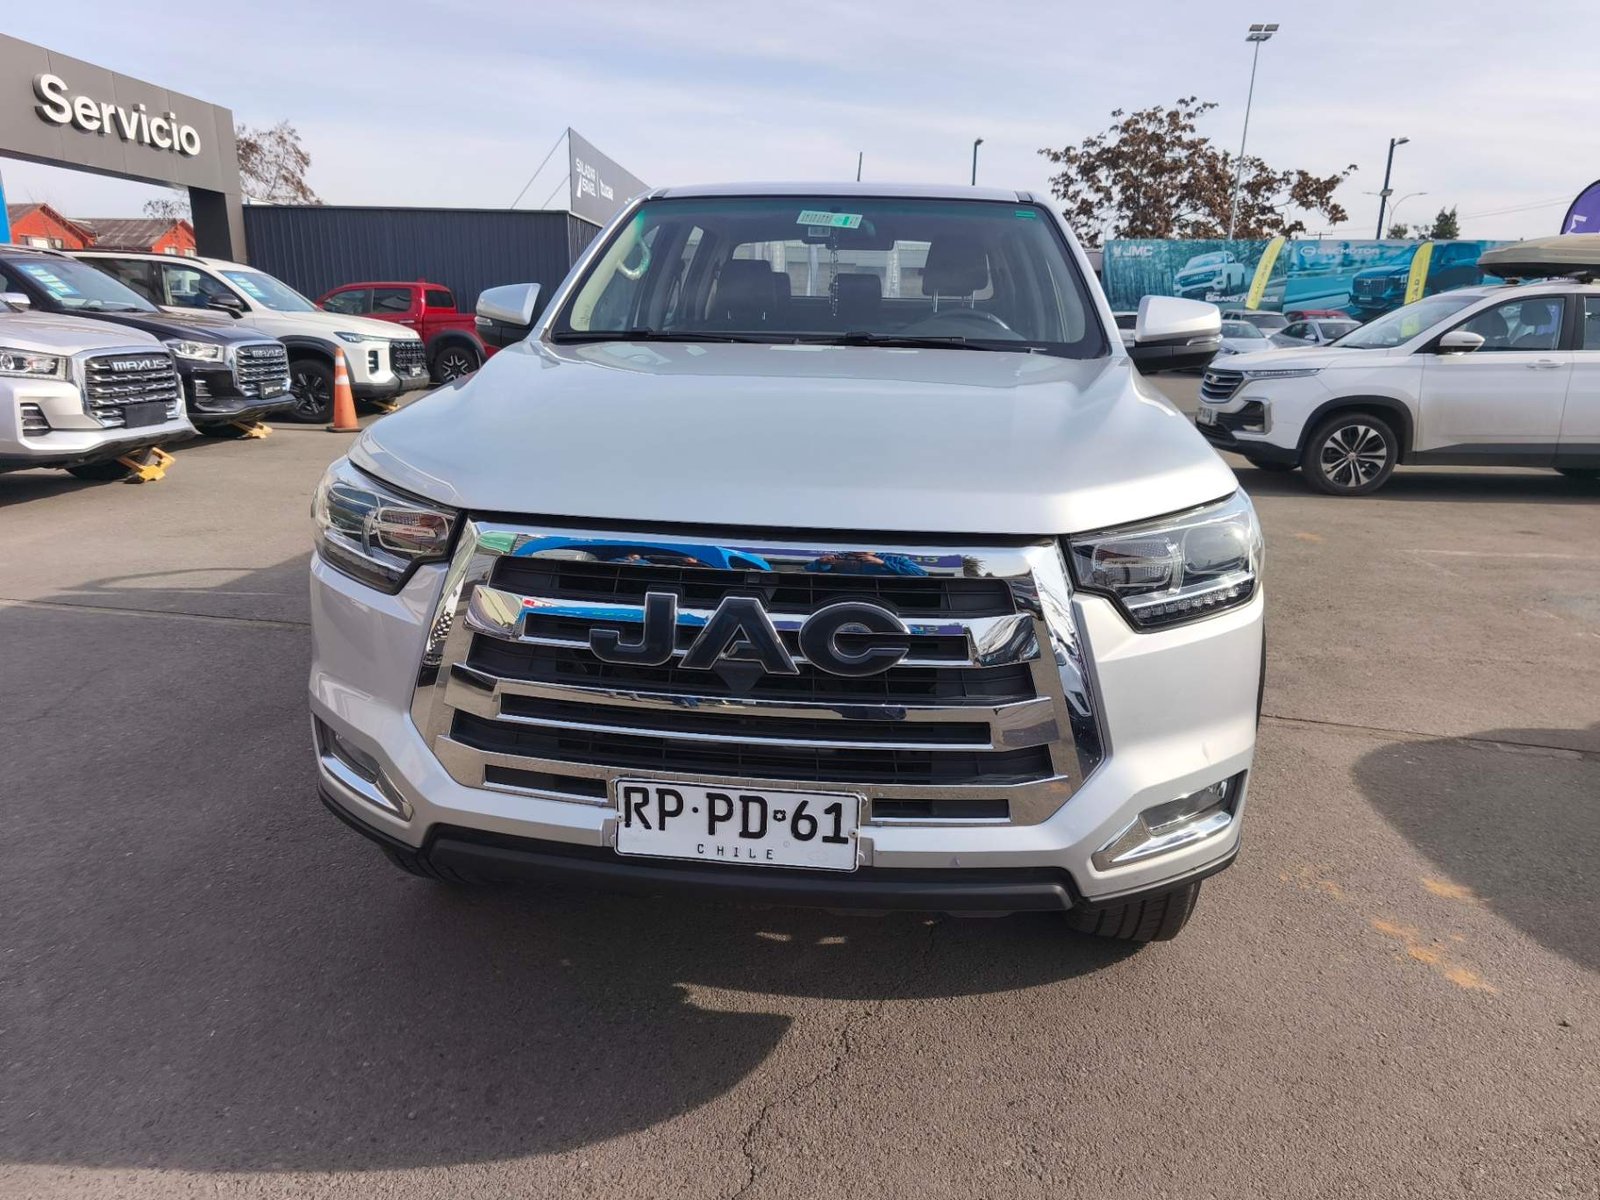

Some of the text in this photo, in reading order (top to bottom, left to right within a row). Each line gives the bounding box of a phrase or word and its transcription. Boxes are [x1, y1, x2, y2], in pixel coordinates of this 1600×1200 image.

[36, 73, 201, 156] Servicio
[1122, 245, 1153, 257] JMC
[112, 358, 167, 372] MAXUS
[589, 591, 910, 677] JAC
[696, 843, 774, 860] CHILE
